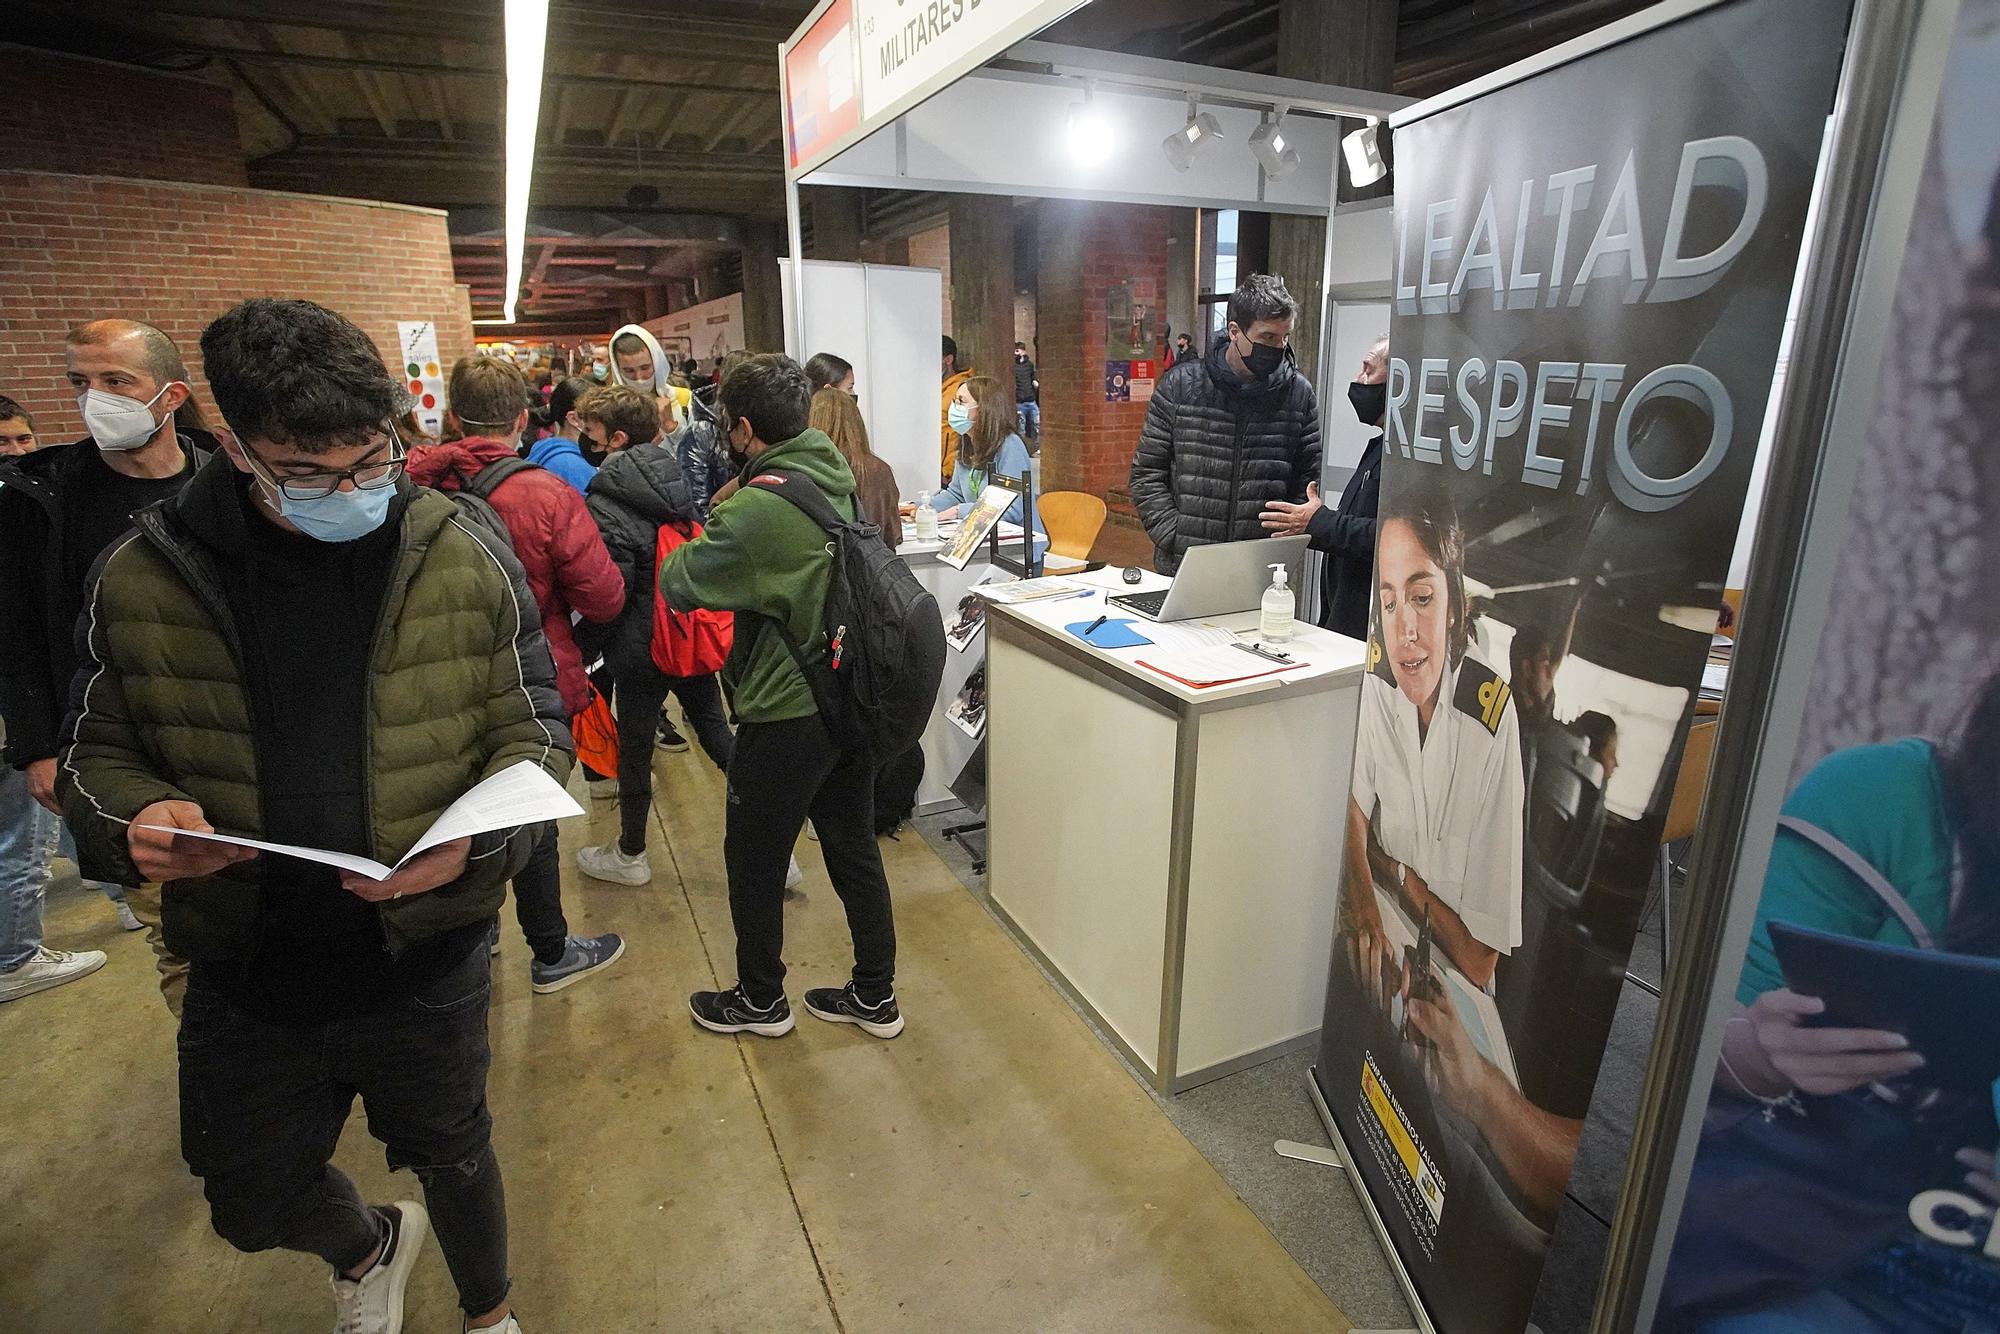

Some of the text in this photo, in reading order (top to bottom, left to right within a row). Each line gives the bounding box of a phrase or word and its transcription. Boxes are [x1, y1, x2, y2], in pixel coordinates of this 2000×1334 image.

[880, 0, 964, 79] MILITARES
[1396, 136, 1769, 314] LEALTAD
[1384, 357, 1733, 512] RESPETO
[1365, 1049, 1392, 1098] COMPARTE
[1391, 1094, 1420, 1145] NUESTROS
[1419, 1140, 1447, 1192] VALORES
[1399, 1162, 1411, 1189] 902
[1411, 1187, 1424, 1213] 432
[1425, 1210, 1437, 1237] 100
